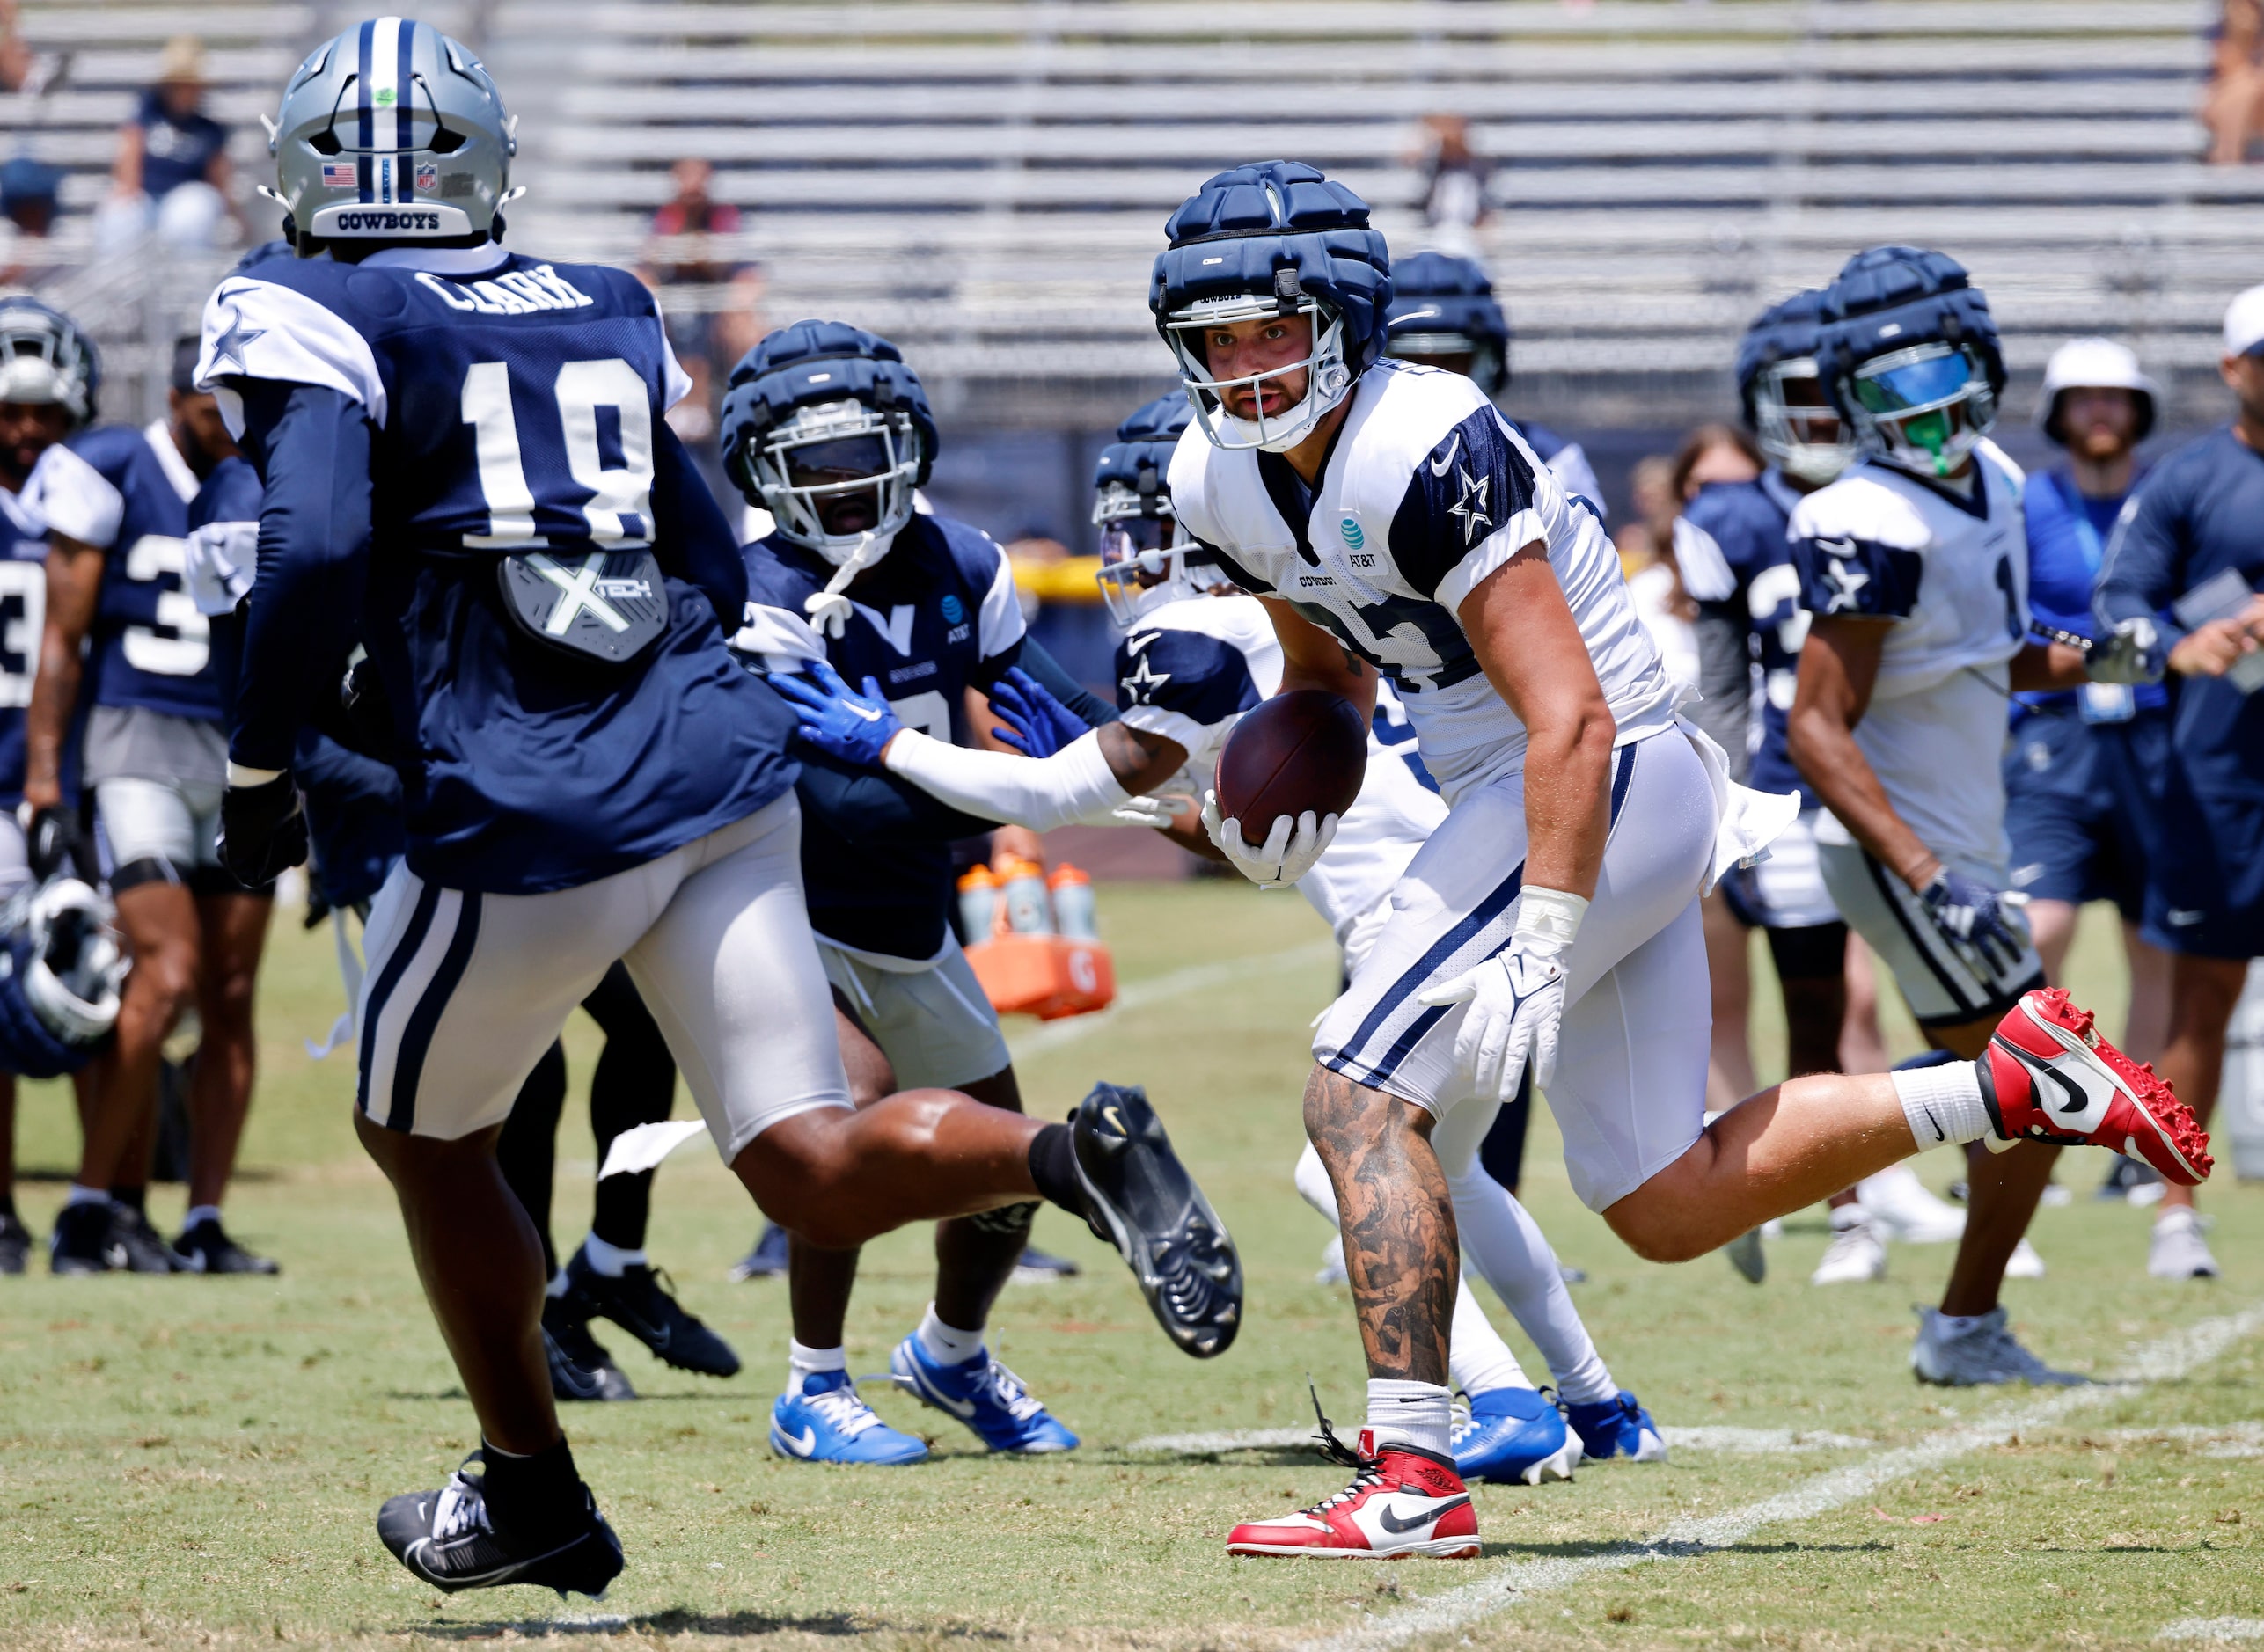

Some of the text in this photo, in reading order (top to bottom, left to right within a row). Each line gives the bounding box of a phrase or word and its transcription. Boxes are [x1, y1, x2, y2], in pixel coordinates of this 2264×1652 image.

[419, 176, 436, 188] NFL
[338, 212, 440, 230] COWBOYS
[414, 264, 594, 315] CLARK
[461, 358, 656, 551] 18
[1349, 554, 1376, 567] AT&T
